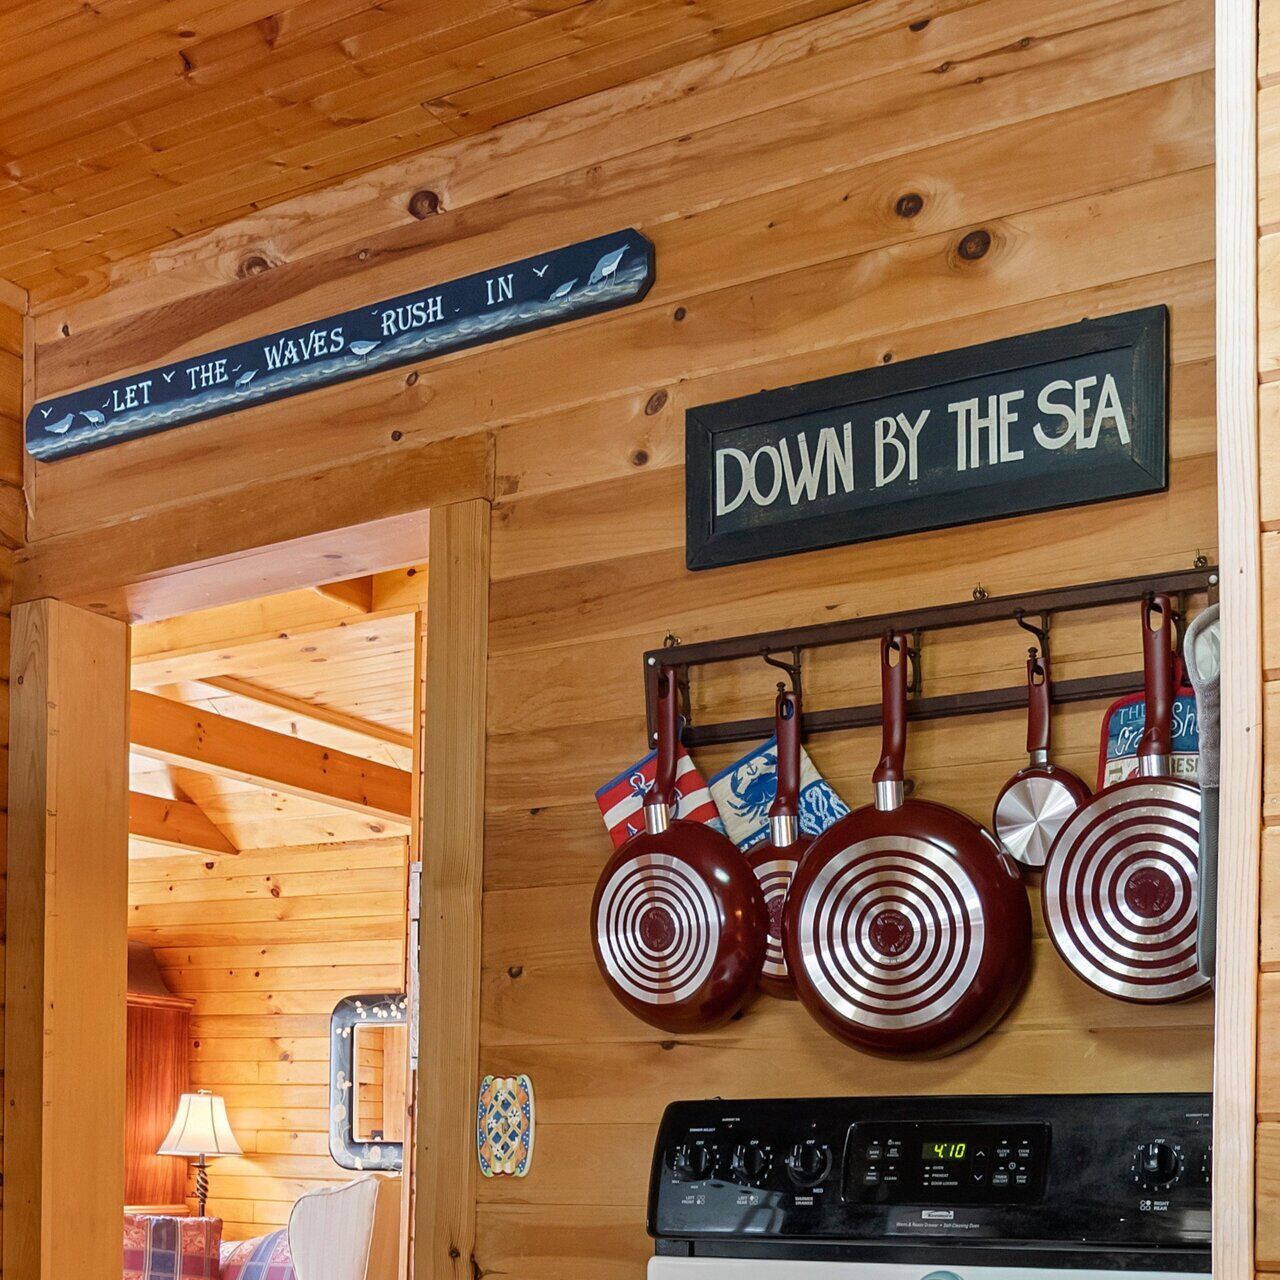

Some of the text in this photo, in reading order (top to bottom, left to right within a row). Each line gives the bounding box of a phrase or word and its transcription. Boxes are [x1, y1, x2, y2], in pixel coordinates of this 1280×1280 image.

[112, 273, 514, 413] LET THE WAVES RUSH IN
[715, 372, 1131, 517] DOWN BY THE SEA
